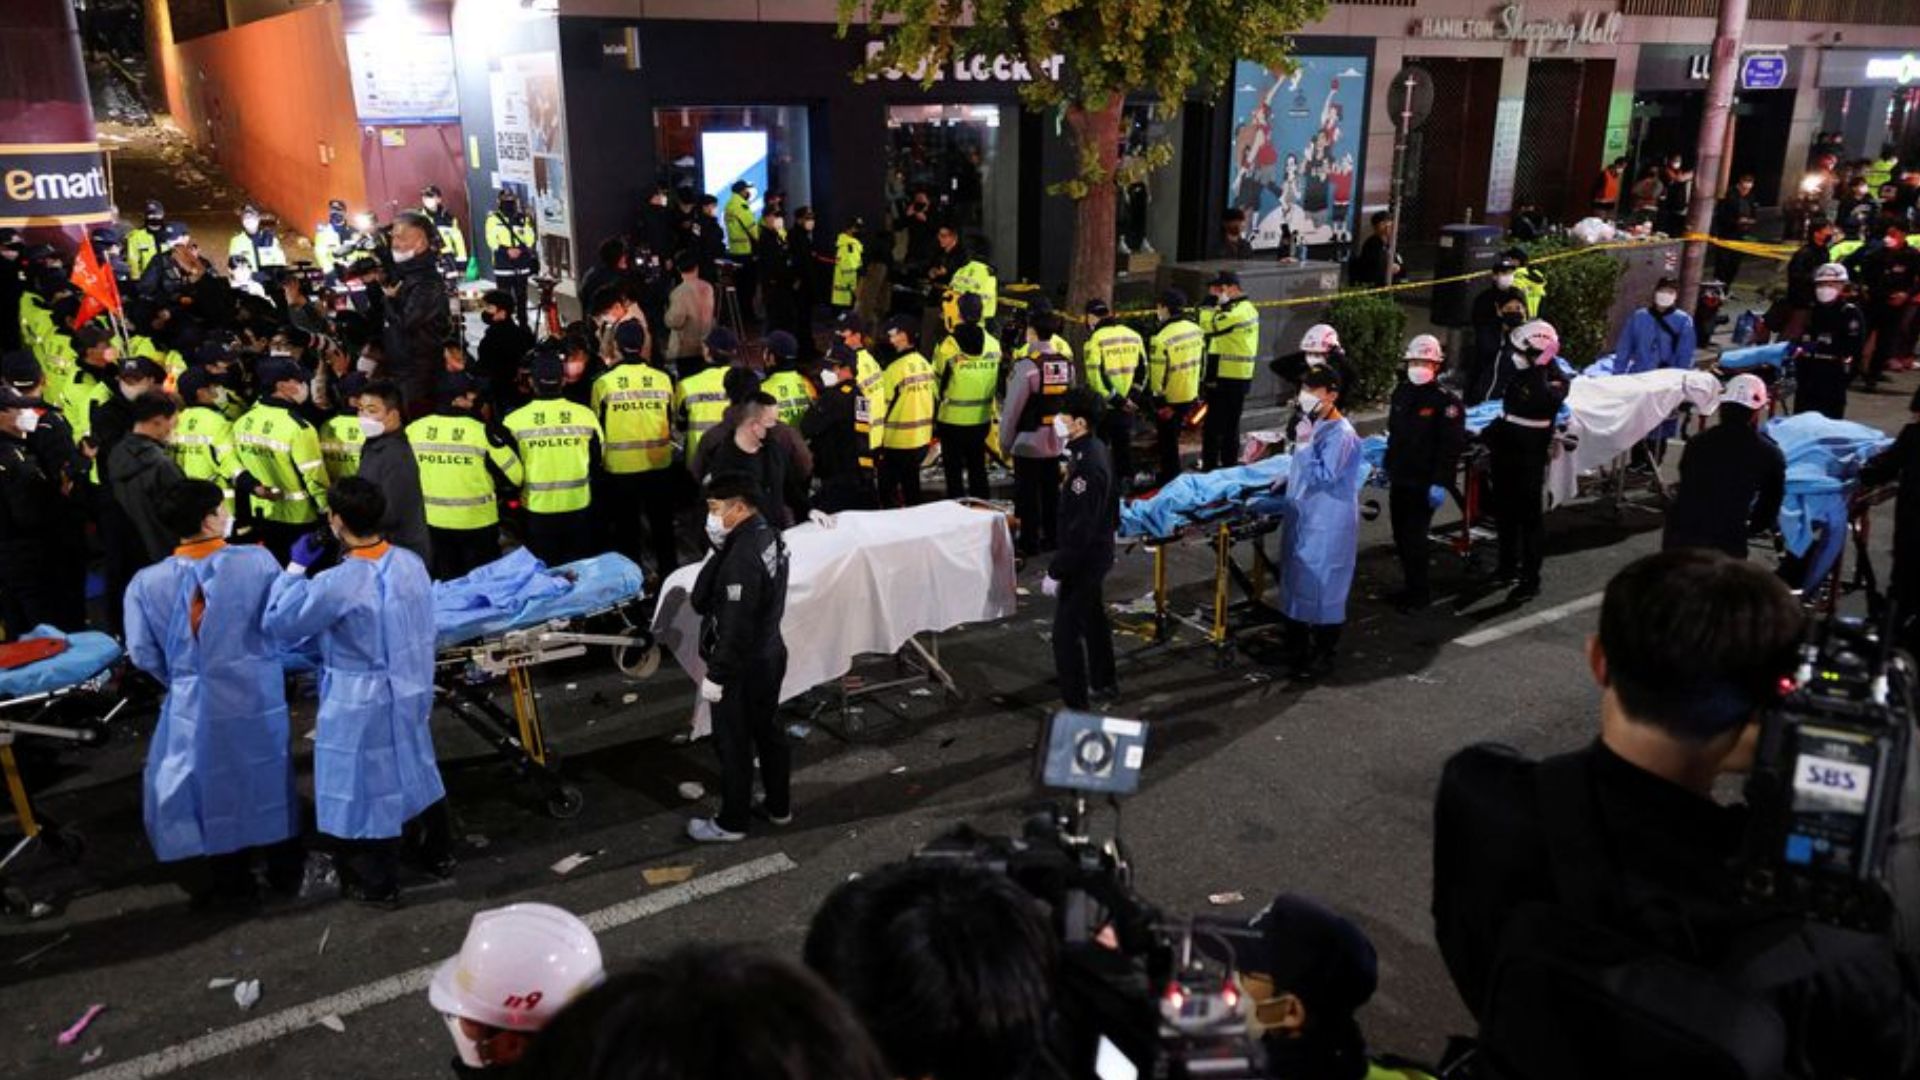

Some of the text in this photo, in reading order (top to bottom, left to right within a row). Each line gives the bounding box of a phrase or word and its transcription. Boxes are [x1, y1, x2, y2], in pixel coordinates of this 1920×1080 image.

[1422, 4, 1622, 57] HAMILTON Shopping Mall
[612, 401, 662, 412] POLICE
[528, 438, 581, 448] POLICE
[418, 454, 474, 465] POLICE
[1806, 765, 1856, 790] SBS
